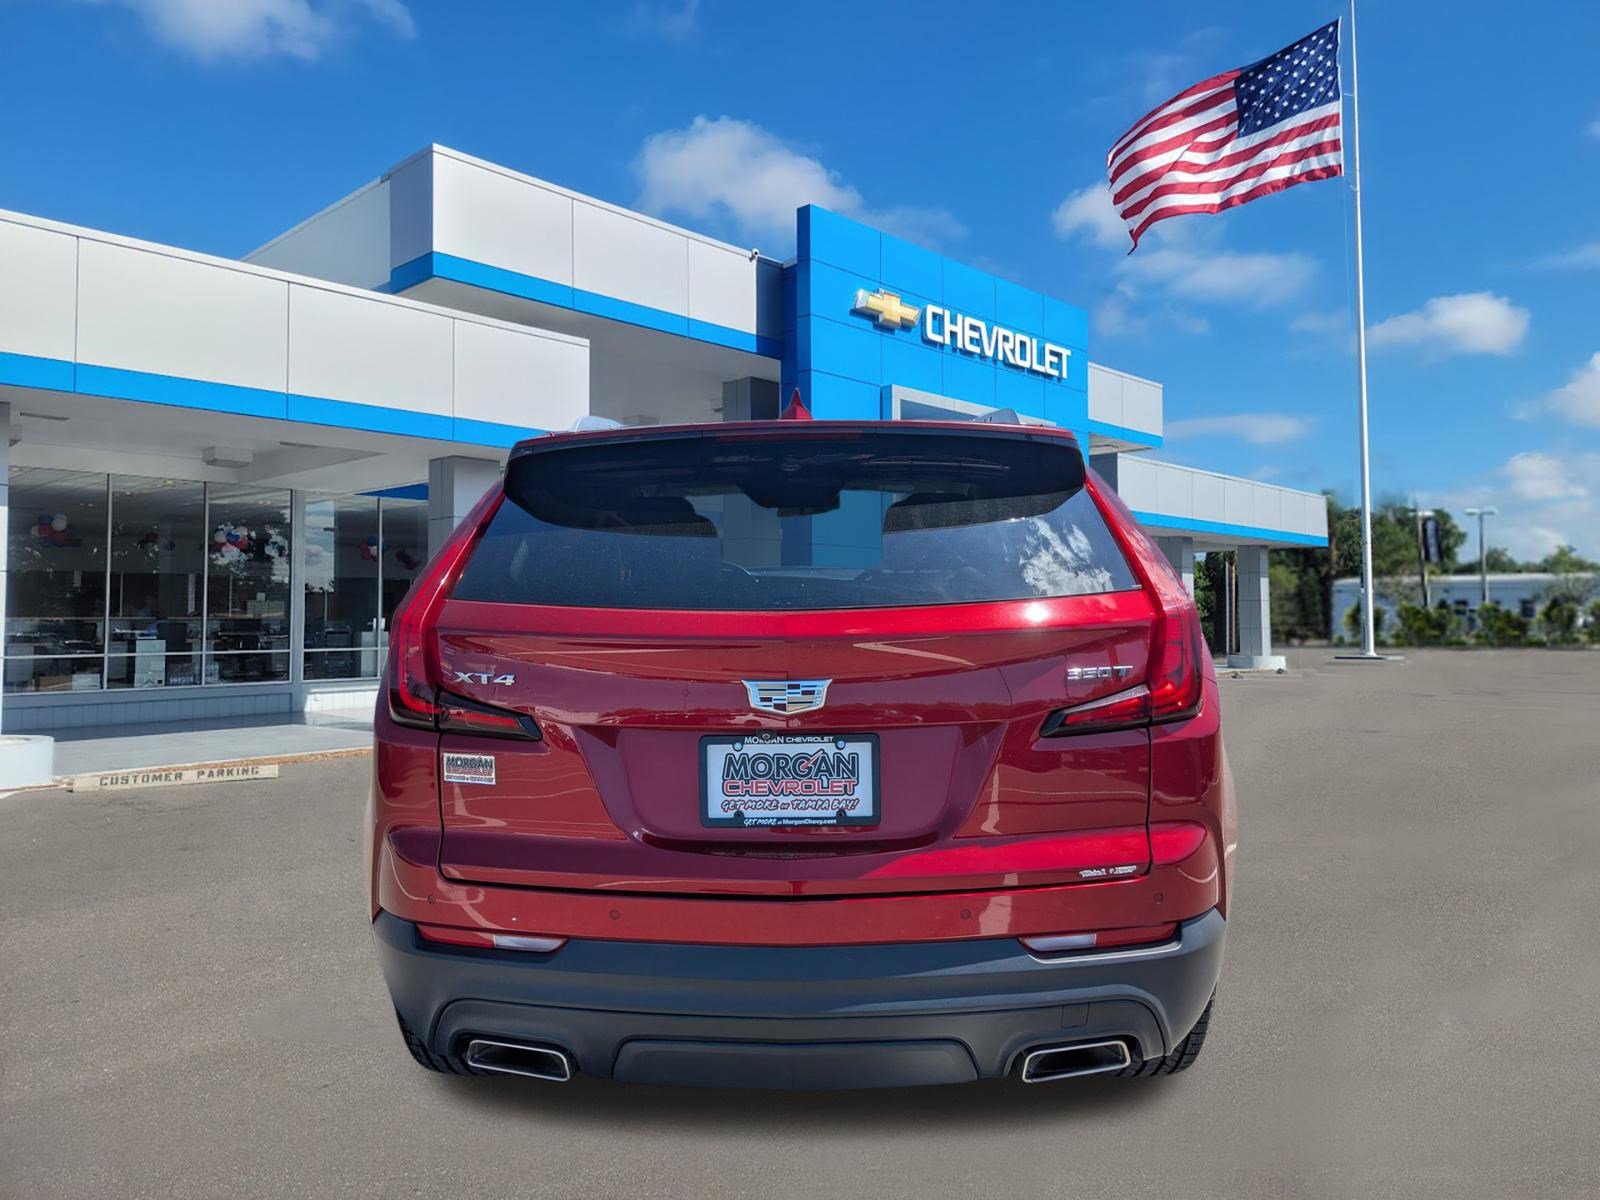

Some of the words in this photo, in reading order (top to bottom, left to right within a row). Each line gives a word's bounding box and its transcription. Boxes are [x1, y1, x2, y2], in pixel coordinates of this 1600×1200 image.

[926, 304, 1071, 379] CHEVROLET
[455, 671, 516, 686] XT4
[446, 756, 493, 769] MORGAN
[723, 749, 859, 780] MORGAN
[100, 771, 184, 787] CUSTOMER
[197, 766, 260, 779] PARKING
[722, 779, 859, 797] CHEVROLET
[721, 799, 745, 812] GET
[745, 799, 778, 810] MORE
[791, 799, 829, 811] TAMPA
[831, 798, 858, 811] BAY!
[743, 819, 757, 827] GET
